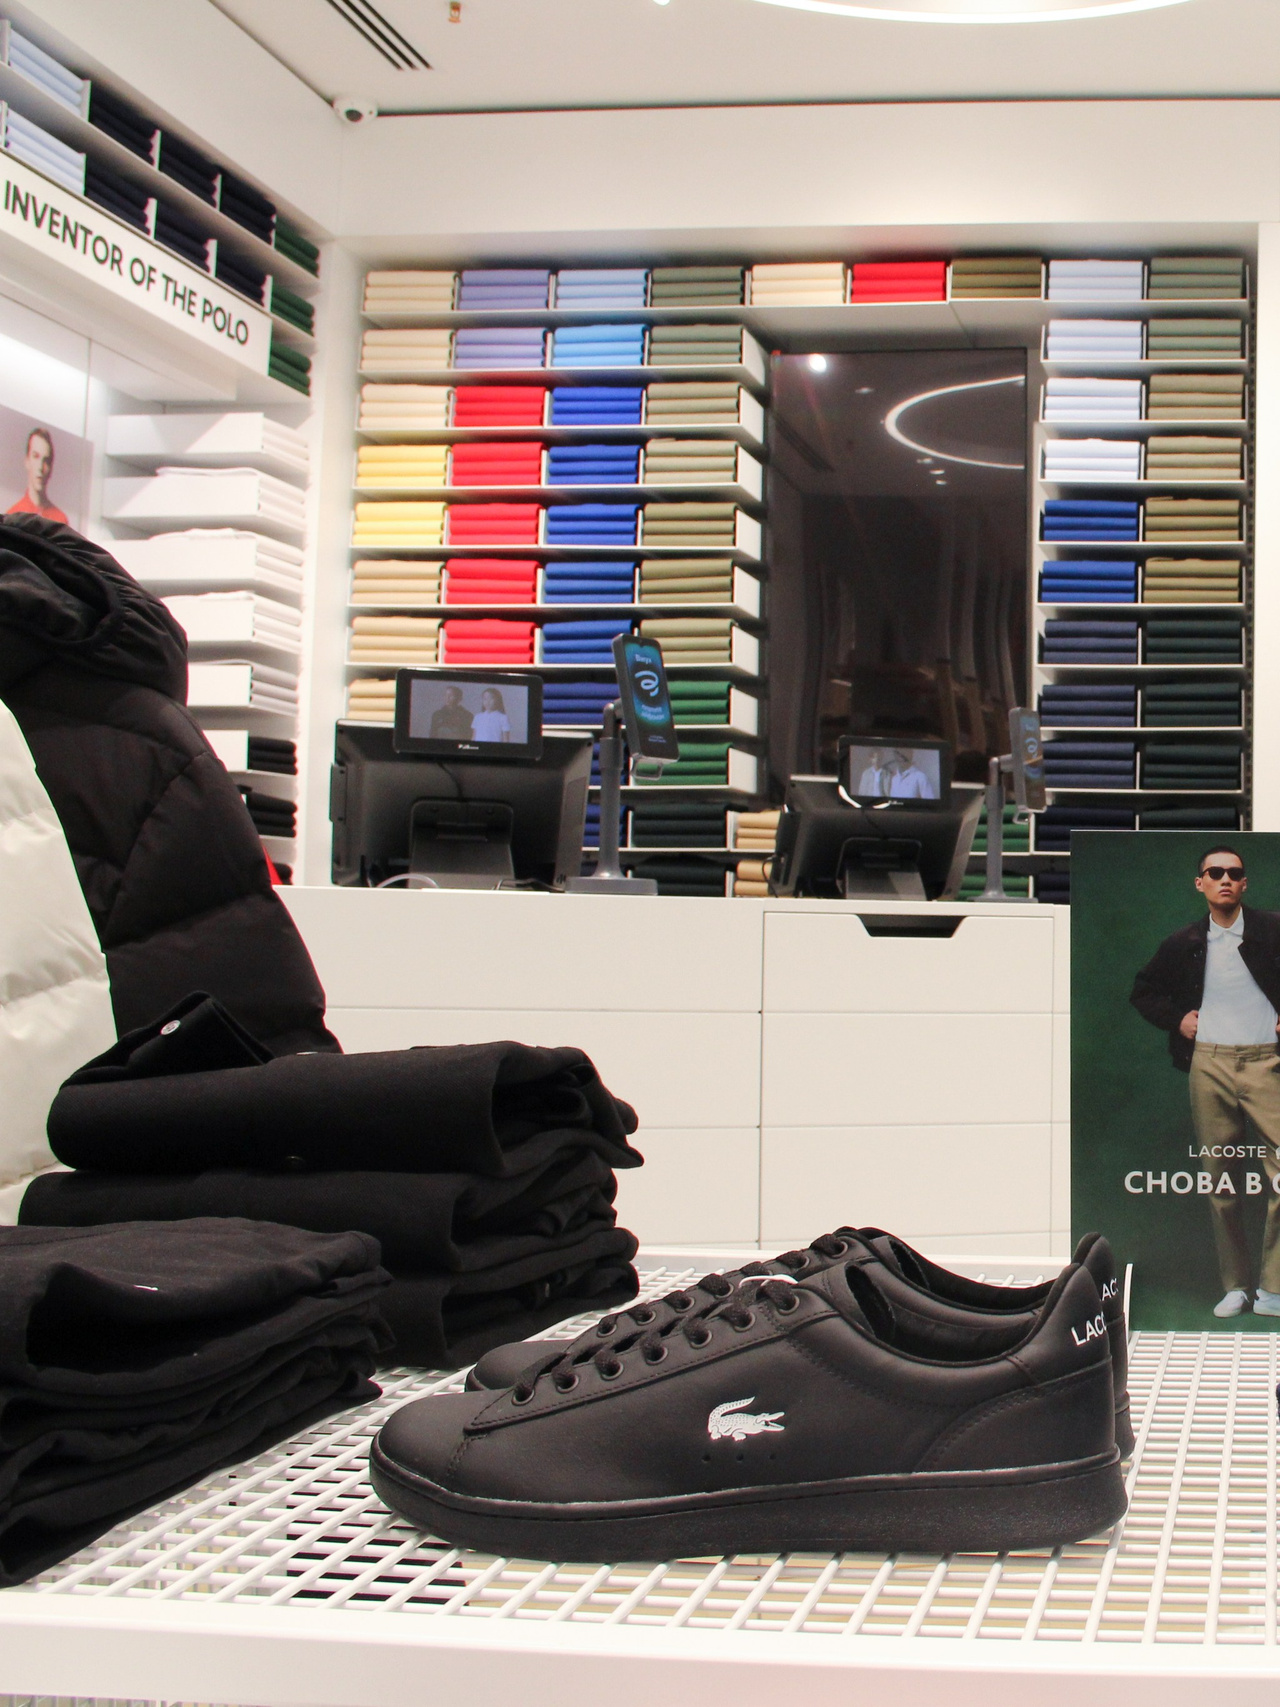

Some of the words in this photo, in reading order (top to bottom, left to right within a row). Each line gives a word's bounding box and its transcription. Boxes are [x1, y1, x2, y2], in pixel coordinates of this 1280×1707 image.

[4, 180, 123, 276] INVENTOR
[130, 257, 157, 292] OF
[161, 273, 197, 317] THE
[202, 298, 249, 346] POLO
[1188, 1145, 1267, 1158] LACOSTE
[1124, 1171, 1236, 1195] СНОВА
[1245, 1172, 1263, 1195] В
[1099, 1278, 1119, 1302] AC
